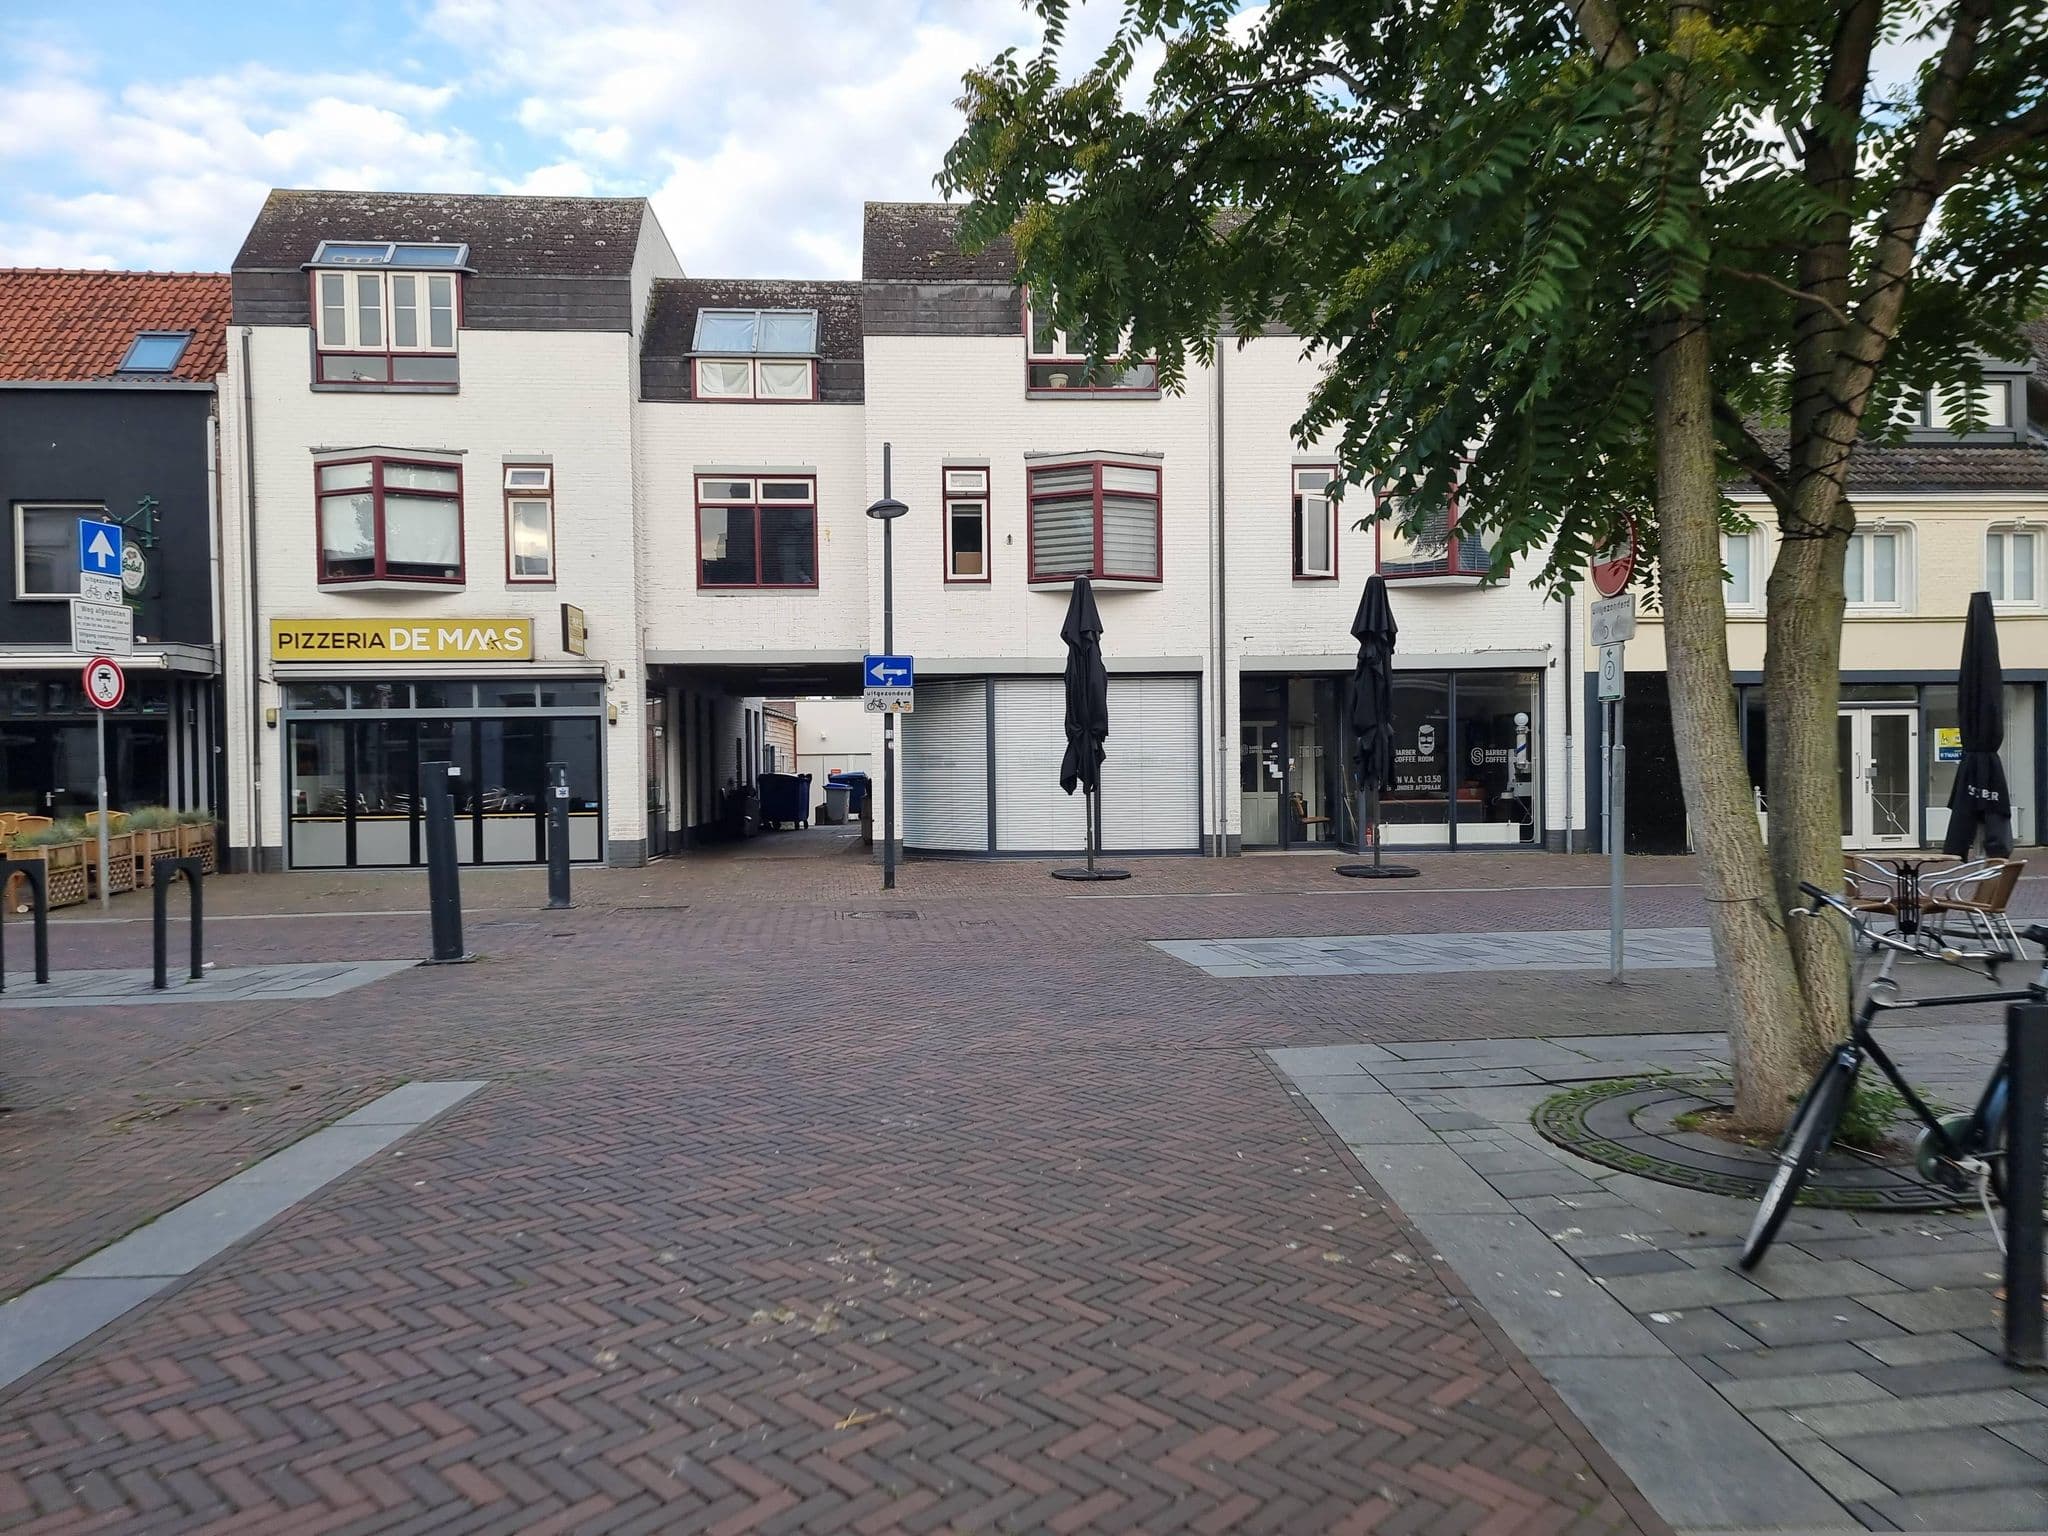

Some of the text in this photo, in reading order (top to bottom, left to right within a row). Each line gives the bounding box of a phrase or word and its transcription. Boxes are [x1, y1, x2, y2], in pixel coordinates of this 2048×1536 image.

[278, 628, 523, 650] PIZZERIA DE MAAS
